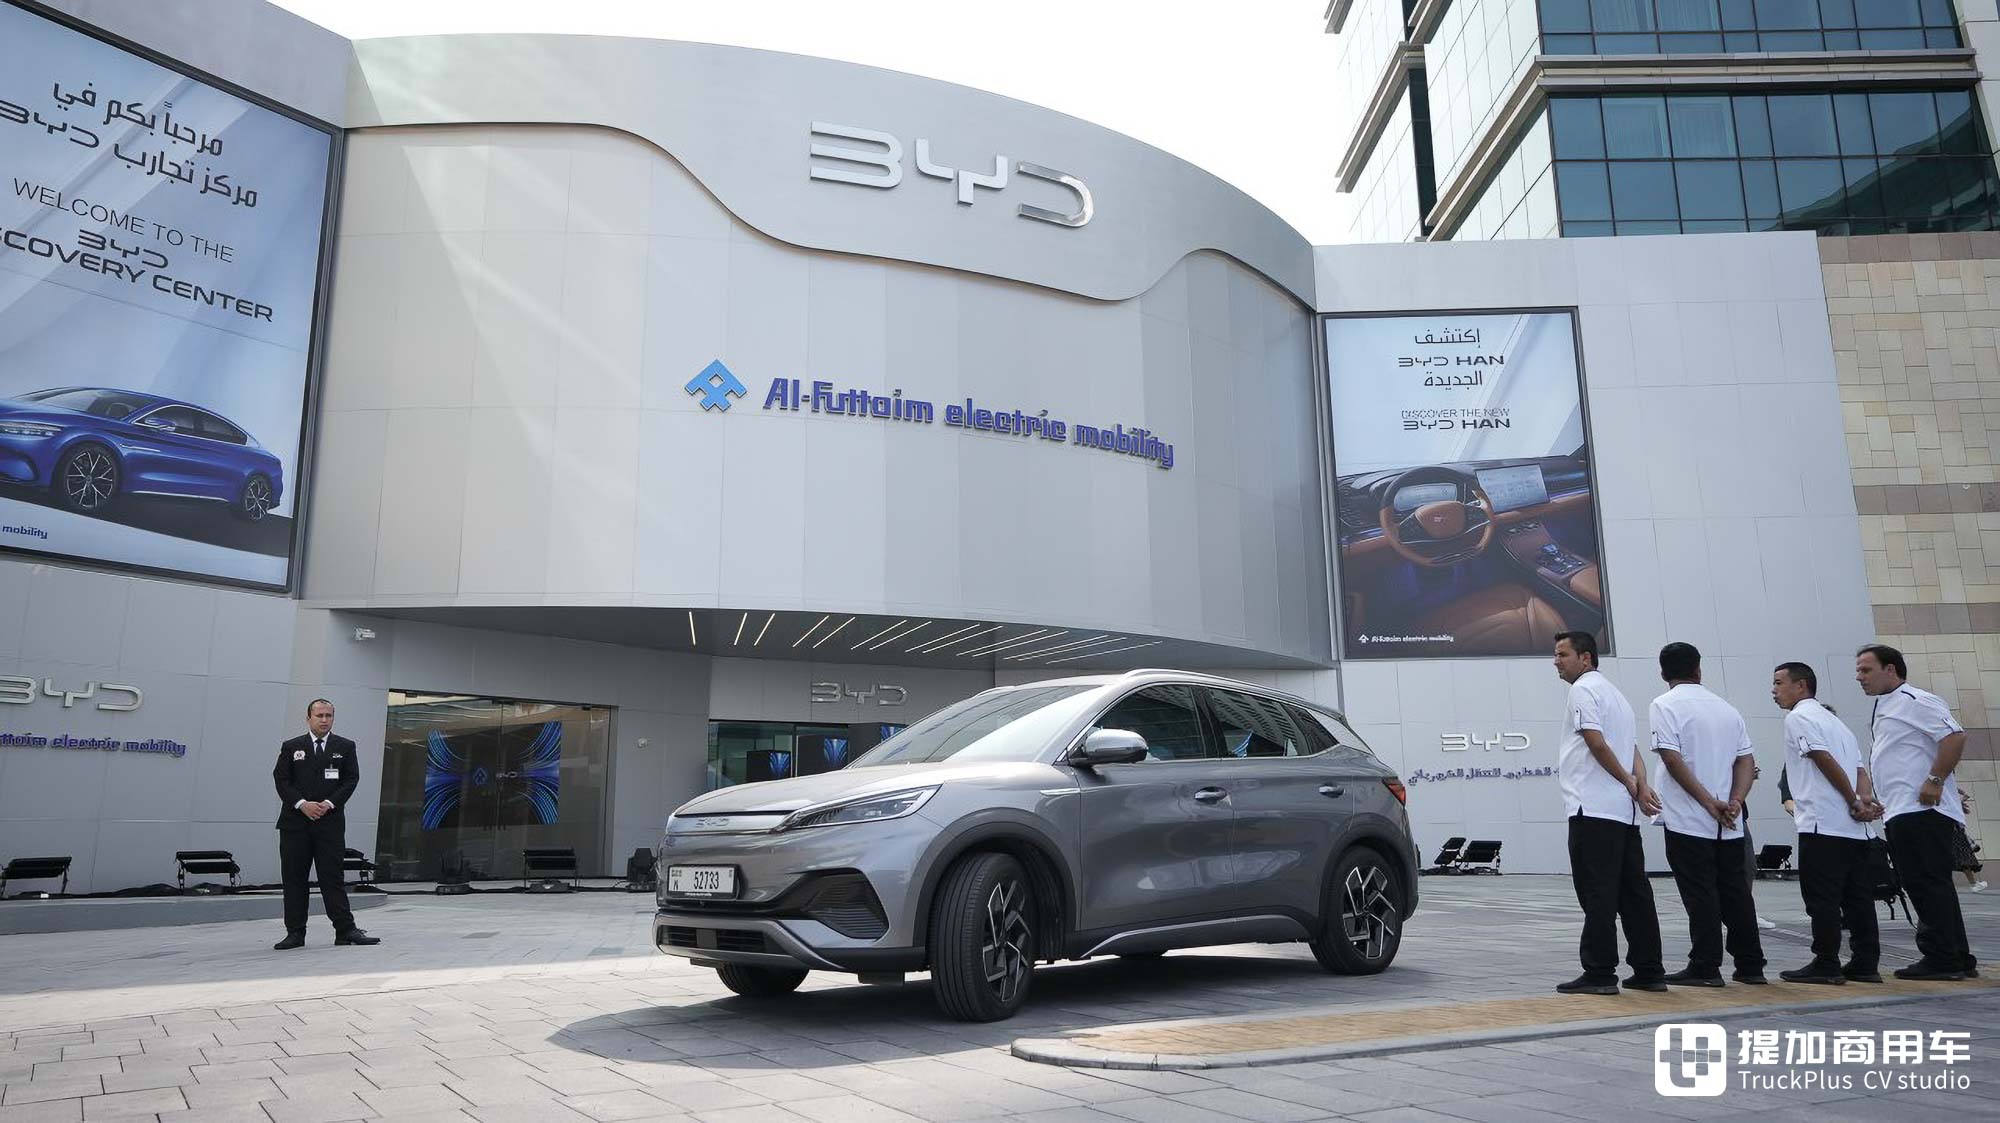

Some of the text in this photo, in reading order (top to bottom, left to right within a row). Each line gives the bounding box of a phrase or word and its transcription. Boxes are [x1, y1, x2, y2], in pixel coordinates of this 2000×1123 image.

[53, 82, 97, 112] في
[103, 100, 156, 136] بكم
[113, 143, 194, 184] تجارب
[809, 120, 1095, 228] BYD
[200, 167, 258, 208] مركز
[14, 177, 235, 263] WELCOME TO THE
[78, 229, 168, 269] BYD
[0, 227, 273, 323] COVERY CENTER
[1414, 327, 1481, 349] إكتشف
[1398, 355, 1504, 367] BYD HAN
[1424, 370, 1483, 390] الجديدة
[762, 377, 1174, 469] Al-Futtaim electric mobility
[1401, 407, 1510, 419] DISCOVER THE NEW
[1403, 418, 1510, 430] BYD HAN
[2, 525, 48, 540] mobility
[0, 675, 143, 711] BYD
[811, 682, 908, 706] BYD
[52, 733, 121, 751] electric
[124, 738, 187, 758] mobility
[1441, 732, 1531, 751] BYD
